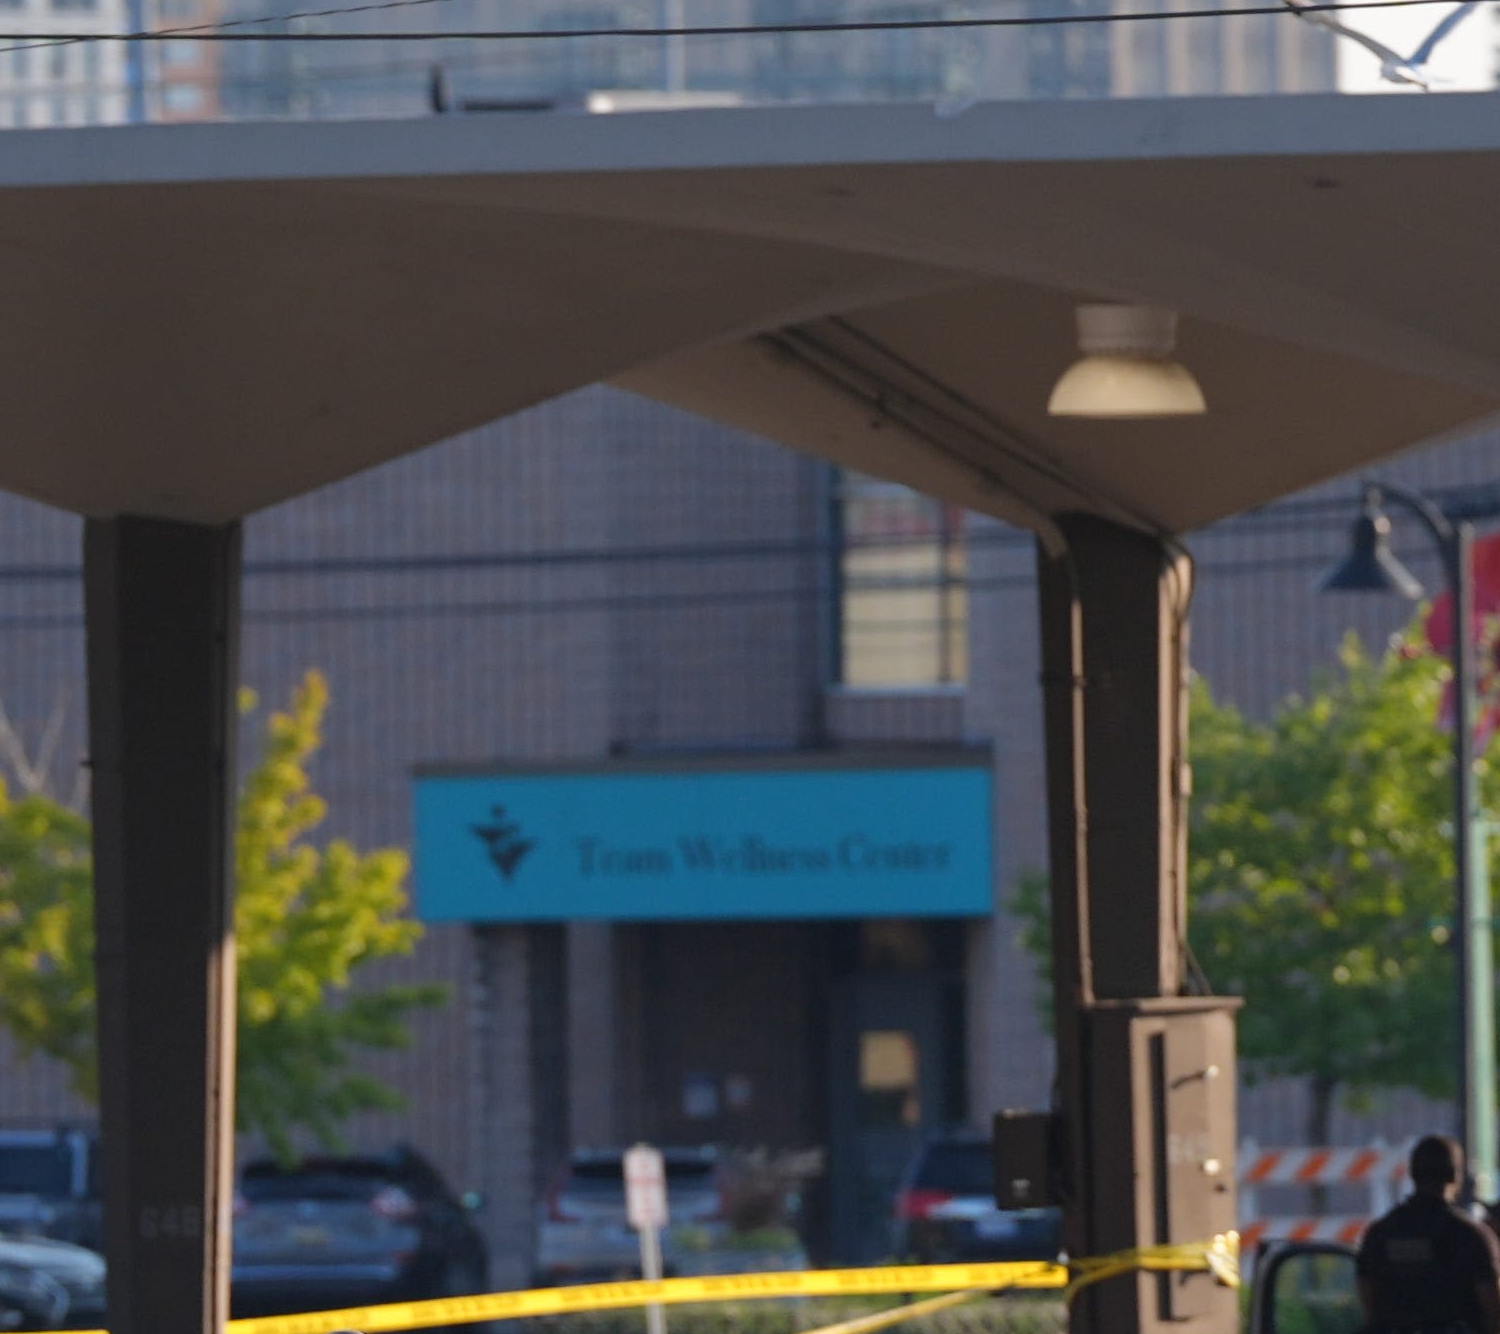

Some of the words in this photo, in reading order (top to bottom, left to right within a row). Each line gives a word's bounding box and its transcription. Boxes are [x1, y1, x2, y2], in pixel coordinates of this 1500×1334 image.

[573, 834, 674, 877] Team
[678, 832, 831, 875] Wellness
[837, 831, 952, 873] Center
